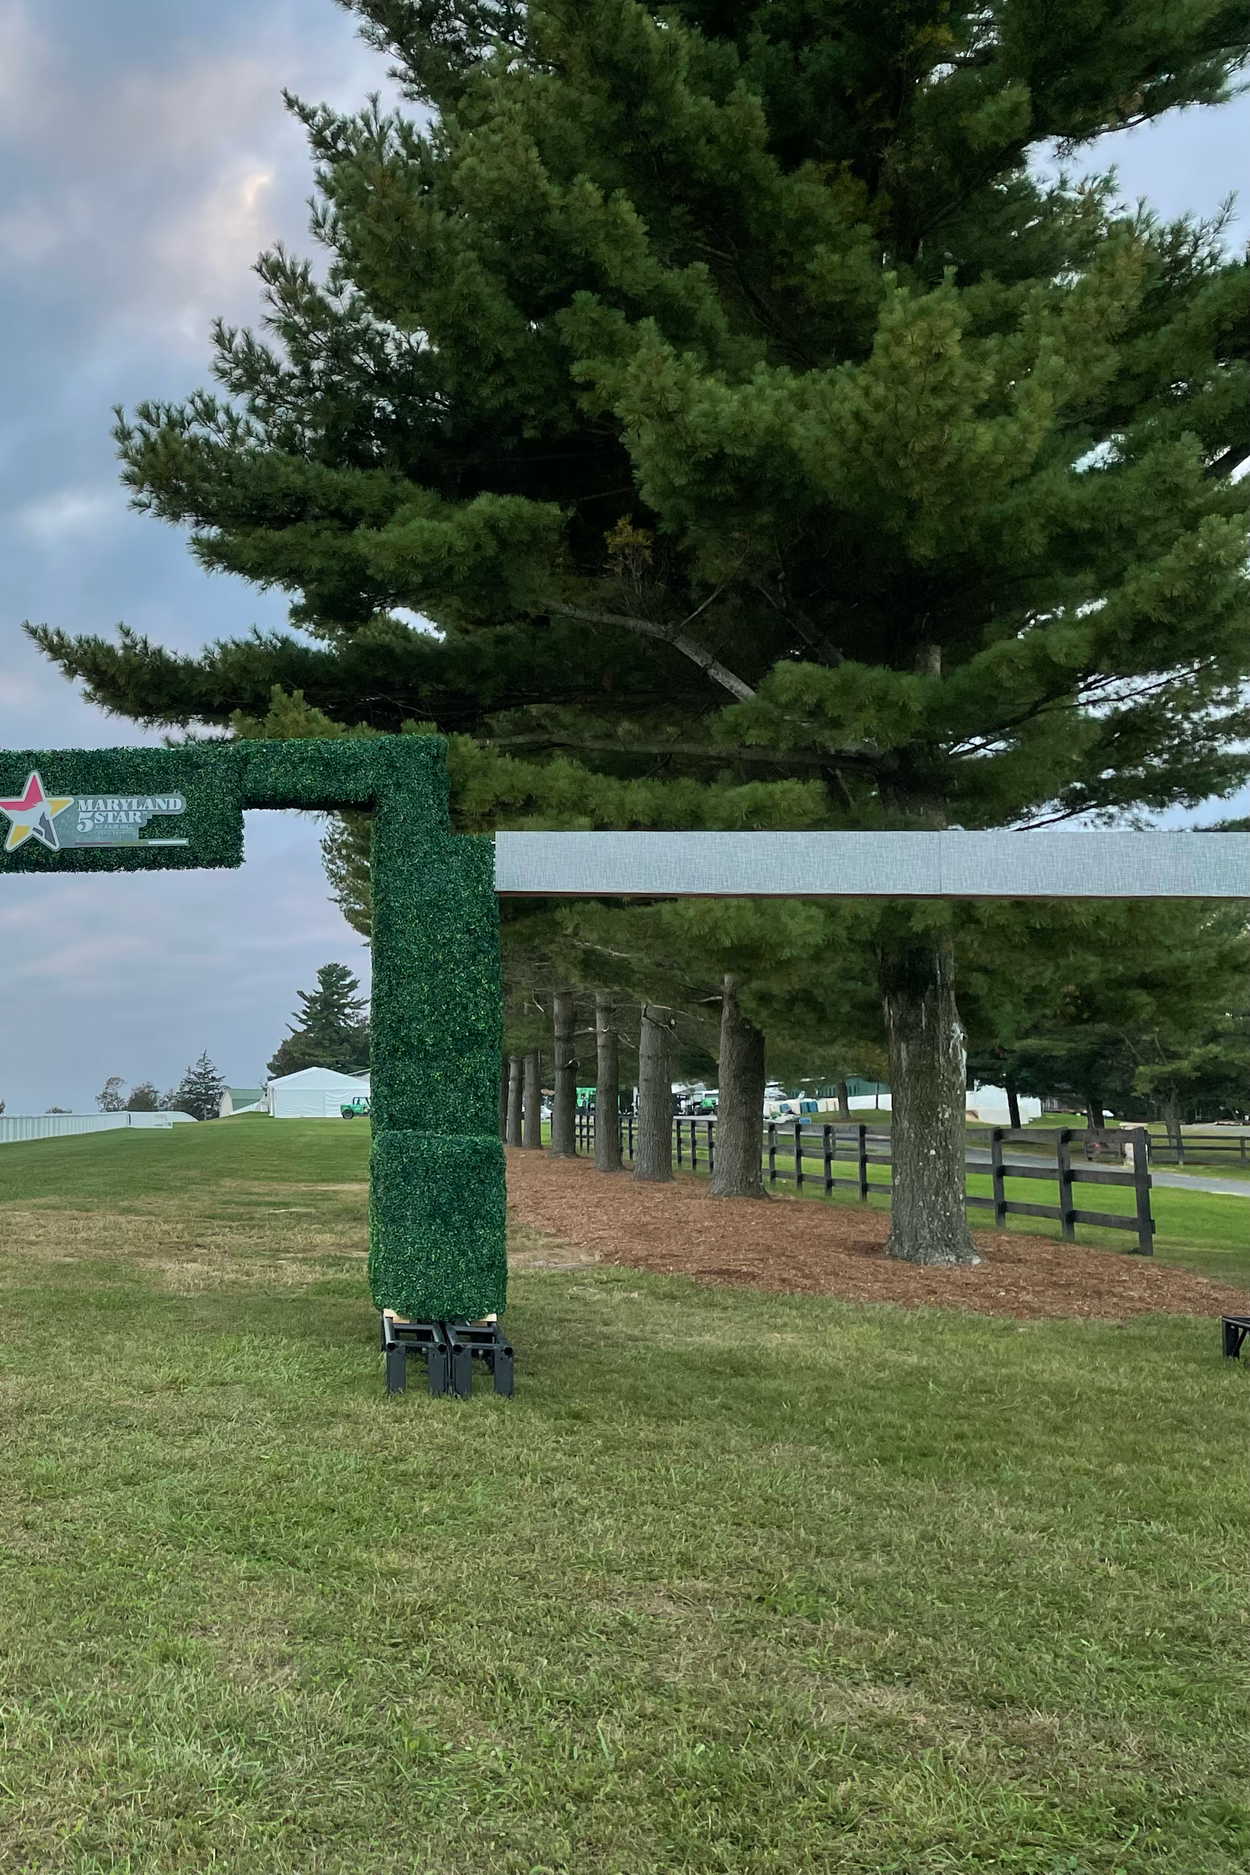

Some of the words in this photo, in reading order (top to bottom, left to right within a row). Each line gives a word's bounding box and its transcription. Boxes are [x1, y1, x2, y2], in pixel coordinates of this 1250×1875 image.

[78, 798, 182, 811] MARYLAND
[76, 811, 94, 832] 5
[94, 811, 142, 823] STAR
